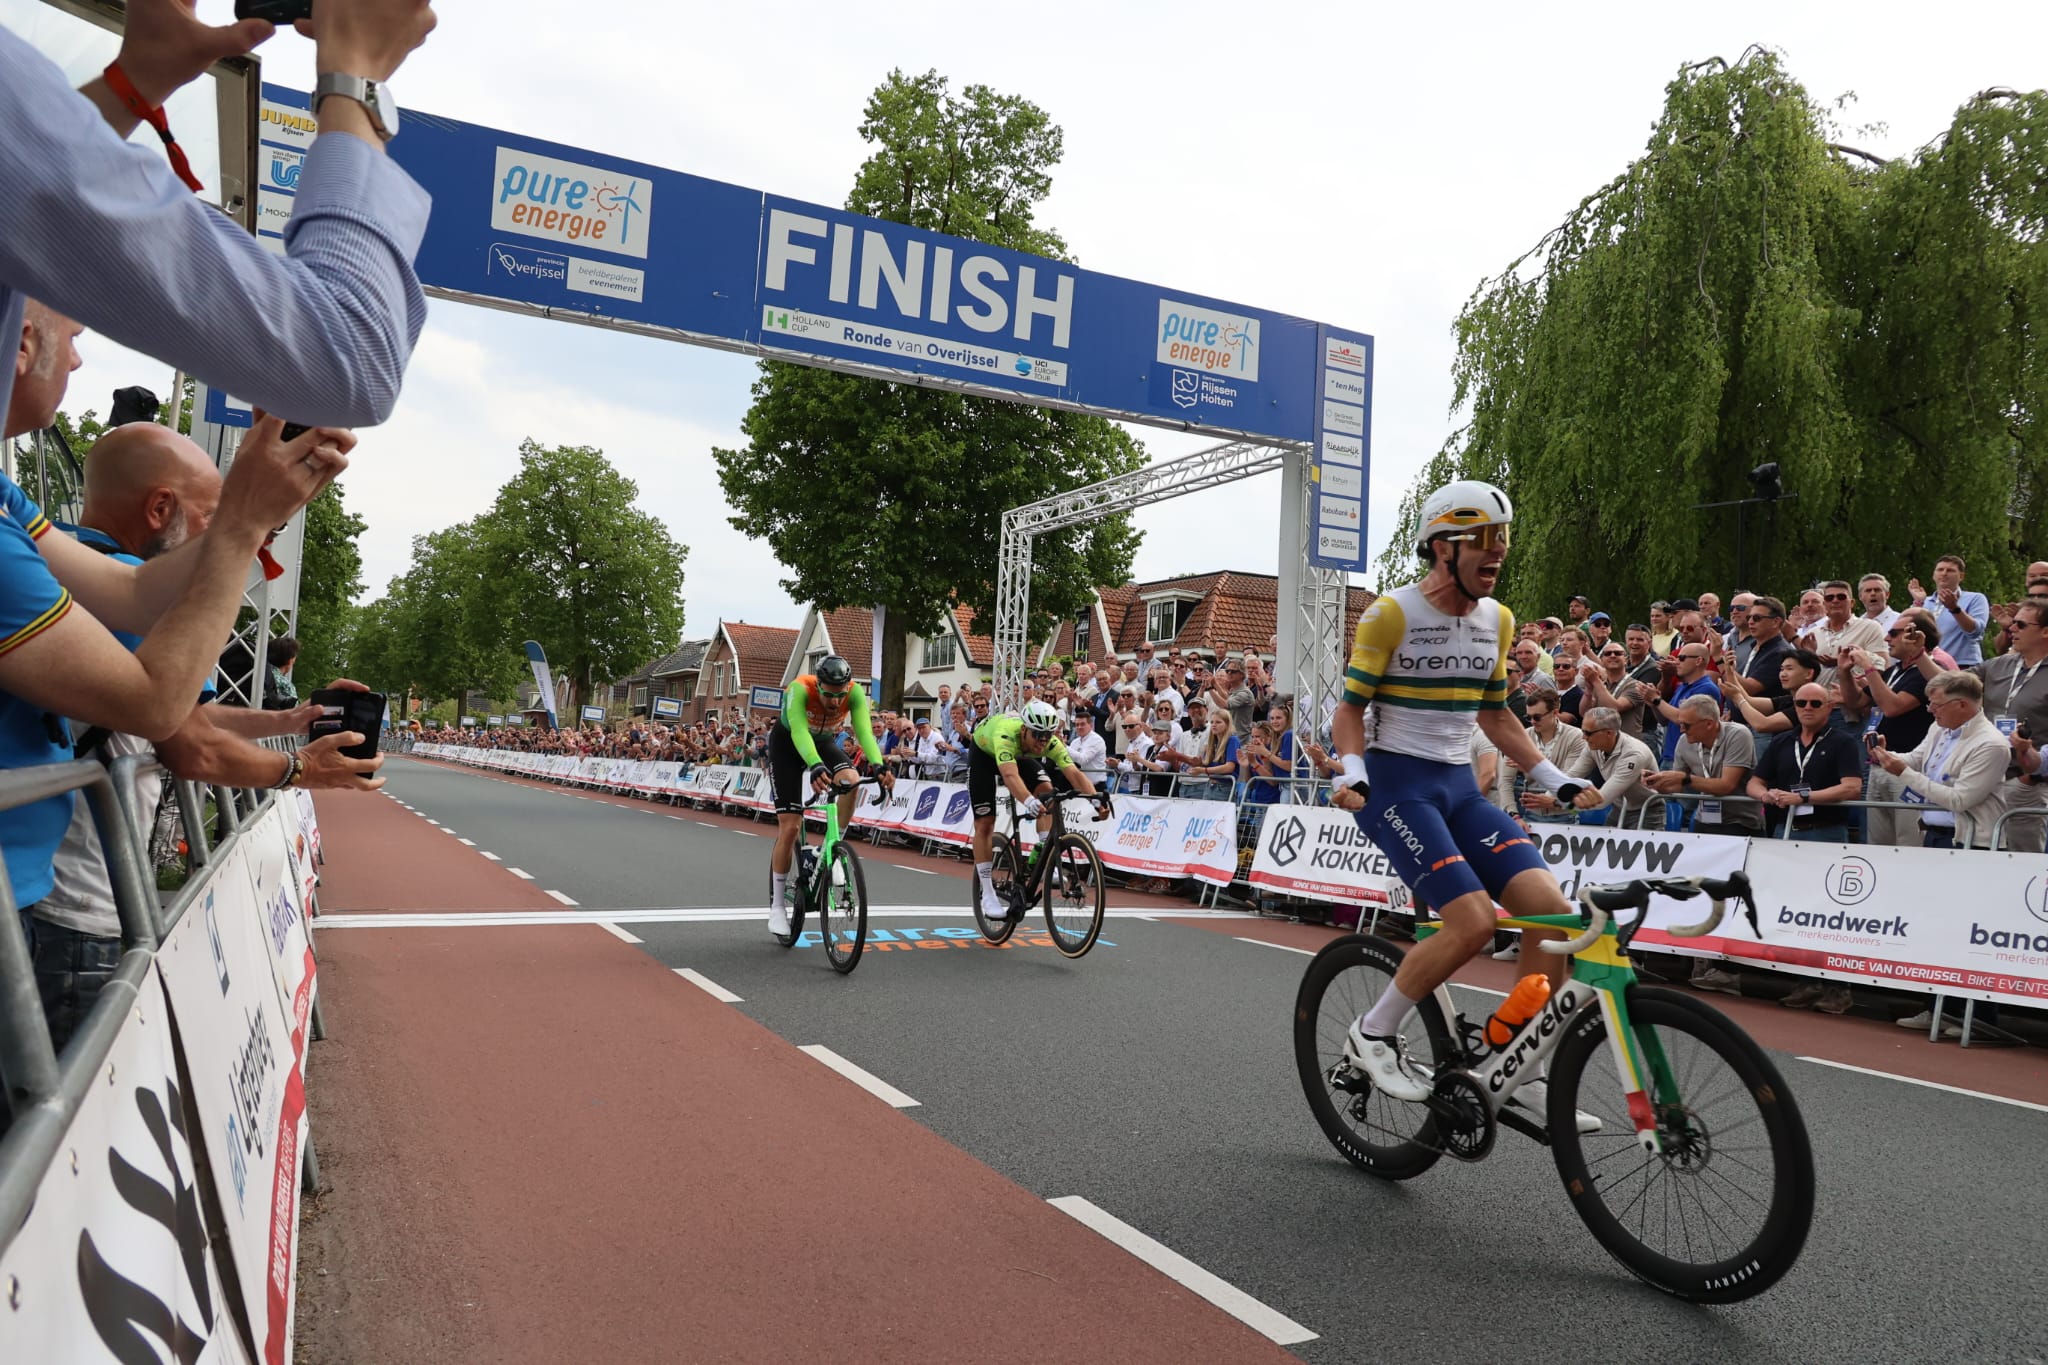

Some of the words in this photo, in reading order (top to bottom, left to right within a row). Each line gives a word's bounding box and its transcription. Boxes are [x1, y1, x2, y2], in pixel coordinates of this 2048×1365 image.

[261, 108, 316, 133] JUMB
[500, 165, 588, 209] pure
[511, 203, 607, 239] energie
[578, 265, 638, 285] beeldbepalend
[589, 278, 638, 294] evenement
[764, 208, 1075, 349] FINISH
[791, 323, 809, 333] CUP
[792, 314, 831, 328] HOLLAND
[1162, 313, 1219, 346] pure
[843, 326, 892, 348] Ronde
[897, 339, 922, 354] van
[926, 343, 999, 369] Overijssel
[1170, 342, 1231, 369] energie
[1035, 360, 1048, 368] UCI
[1200, 393, 1233, 407] Holten
[1201, 381, 1237, 397] Rijssen
[1399, 652, 1495, 671] brennan
[1116, 811, 1152, 834] pure
[1117, 833, 1154, 851] energie
[1317, 823, 1376, 849] HUIS
[1310, 847, 1399, 877] KOKKEL
[1388, 885, 1409, 910] 103
[1777, 905, 1909, 938] bandwerk
[795, 925, 983, 948] pure
[1797, 930, 1881, 946] merkenbouwers
[1827, 956, 1866, 971] RONDE
[1868, 961, 1893, 975] VAN
[1895, 965, 1964, 984] OVERIJSSEL
[1967, 974, 1996, 988] BIKE
[1998, 978, 2048, 995] EVENTS
